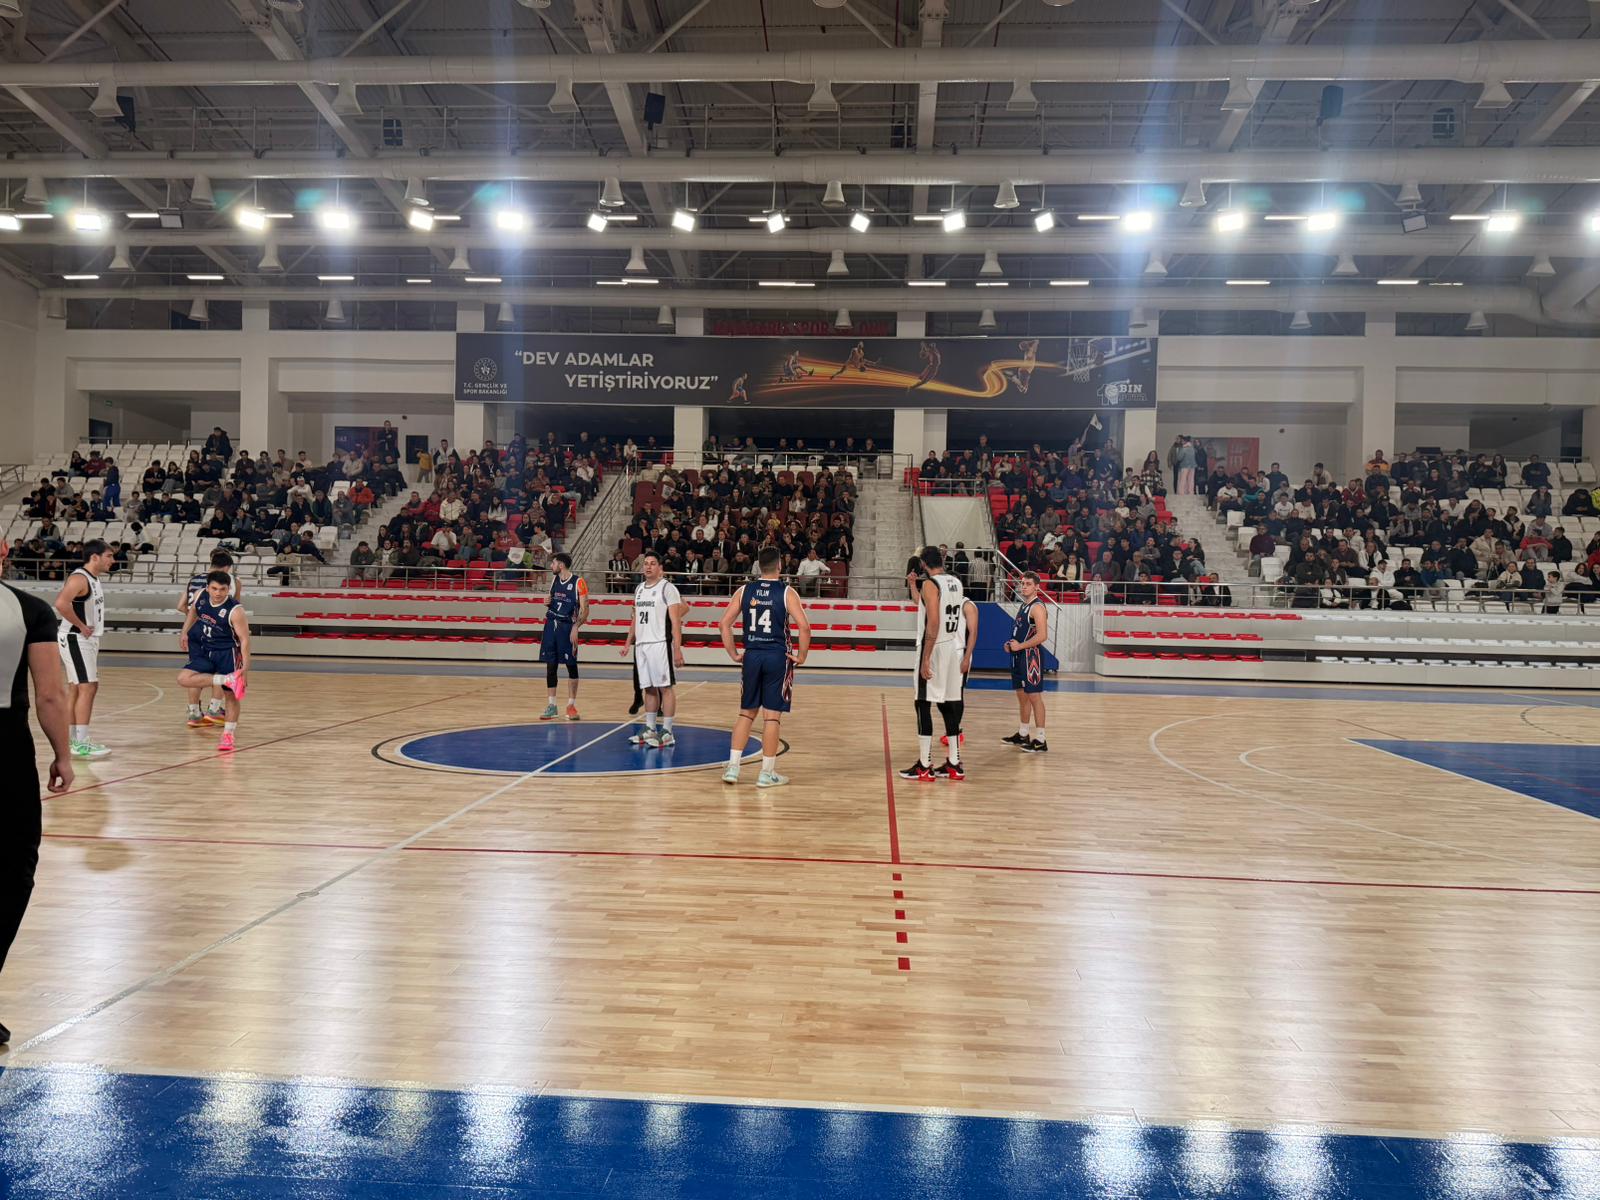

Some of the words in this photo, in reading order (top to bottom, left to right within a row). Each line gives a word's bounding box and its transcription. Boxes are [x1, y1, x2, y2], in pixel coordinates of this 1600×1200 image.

[514, 350, 560, 366] “DEV
[564, 351, 654, 368] ADAMLAR
[474, 382, 499, 390] GENÇLİK
[564, 370, 719, 393] YETİŞTİRİYORUZ”
[557, 602, 563, 611] 7
[639, 611, 649, 625] 24
[749, 608, 772, 634] 14
